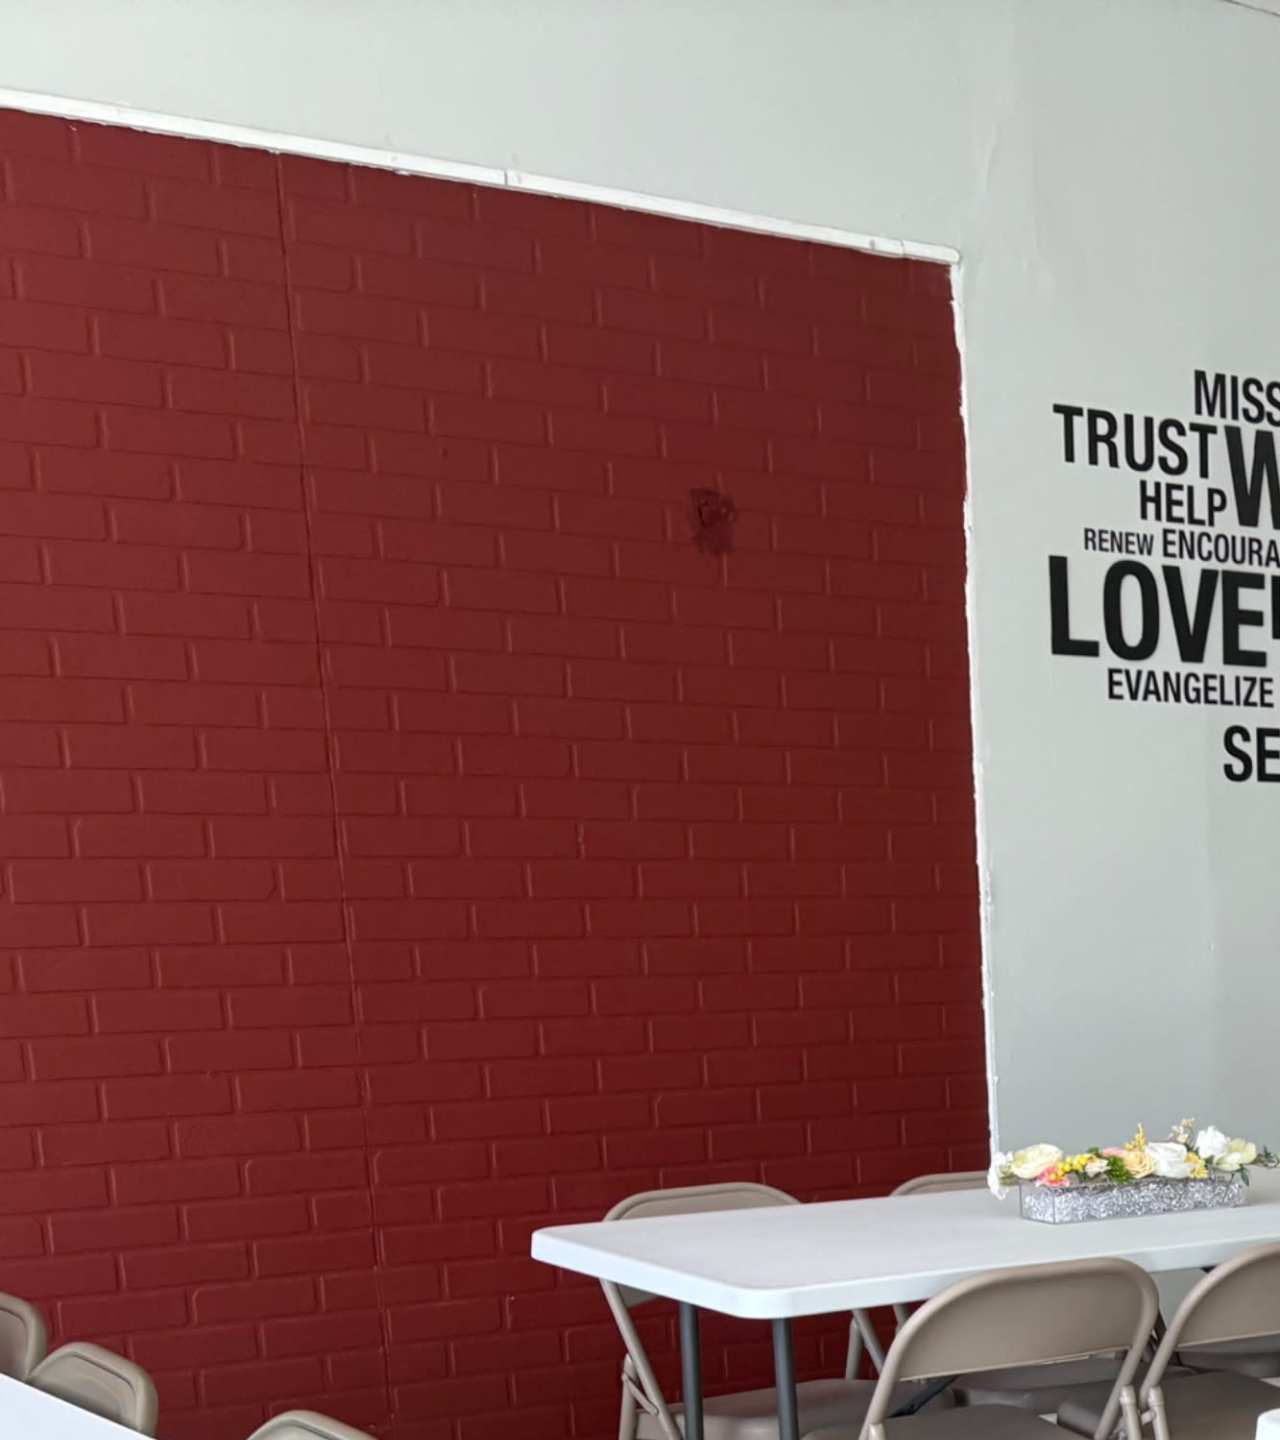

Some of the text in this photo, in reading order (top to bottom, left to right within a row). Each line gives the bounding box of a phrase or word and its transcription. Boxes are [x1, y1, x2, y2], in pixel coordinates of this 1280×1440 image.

[1052, 403, 1218, 480] TRUST
[1139, 479, 1227, 528] HELP
[1084, 527, 1154, 556] RENEW
[1048, 555, 1267, 668] LOVE
[1107, 667, 1274, 708] EVANGELIZE
